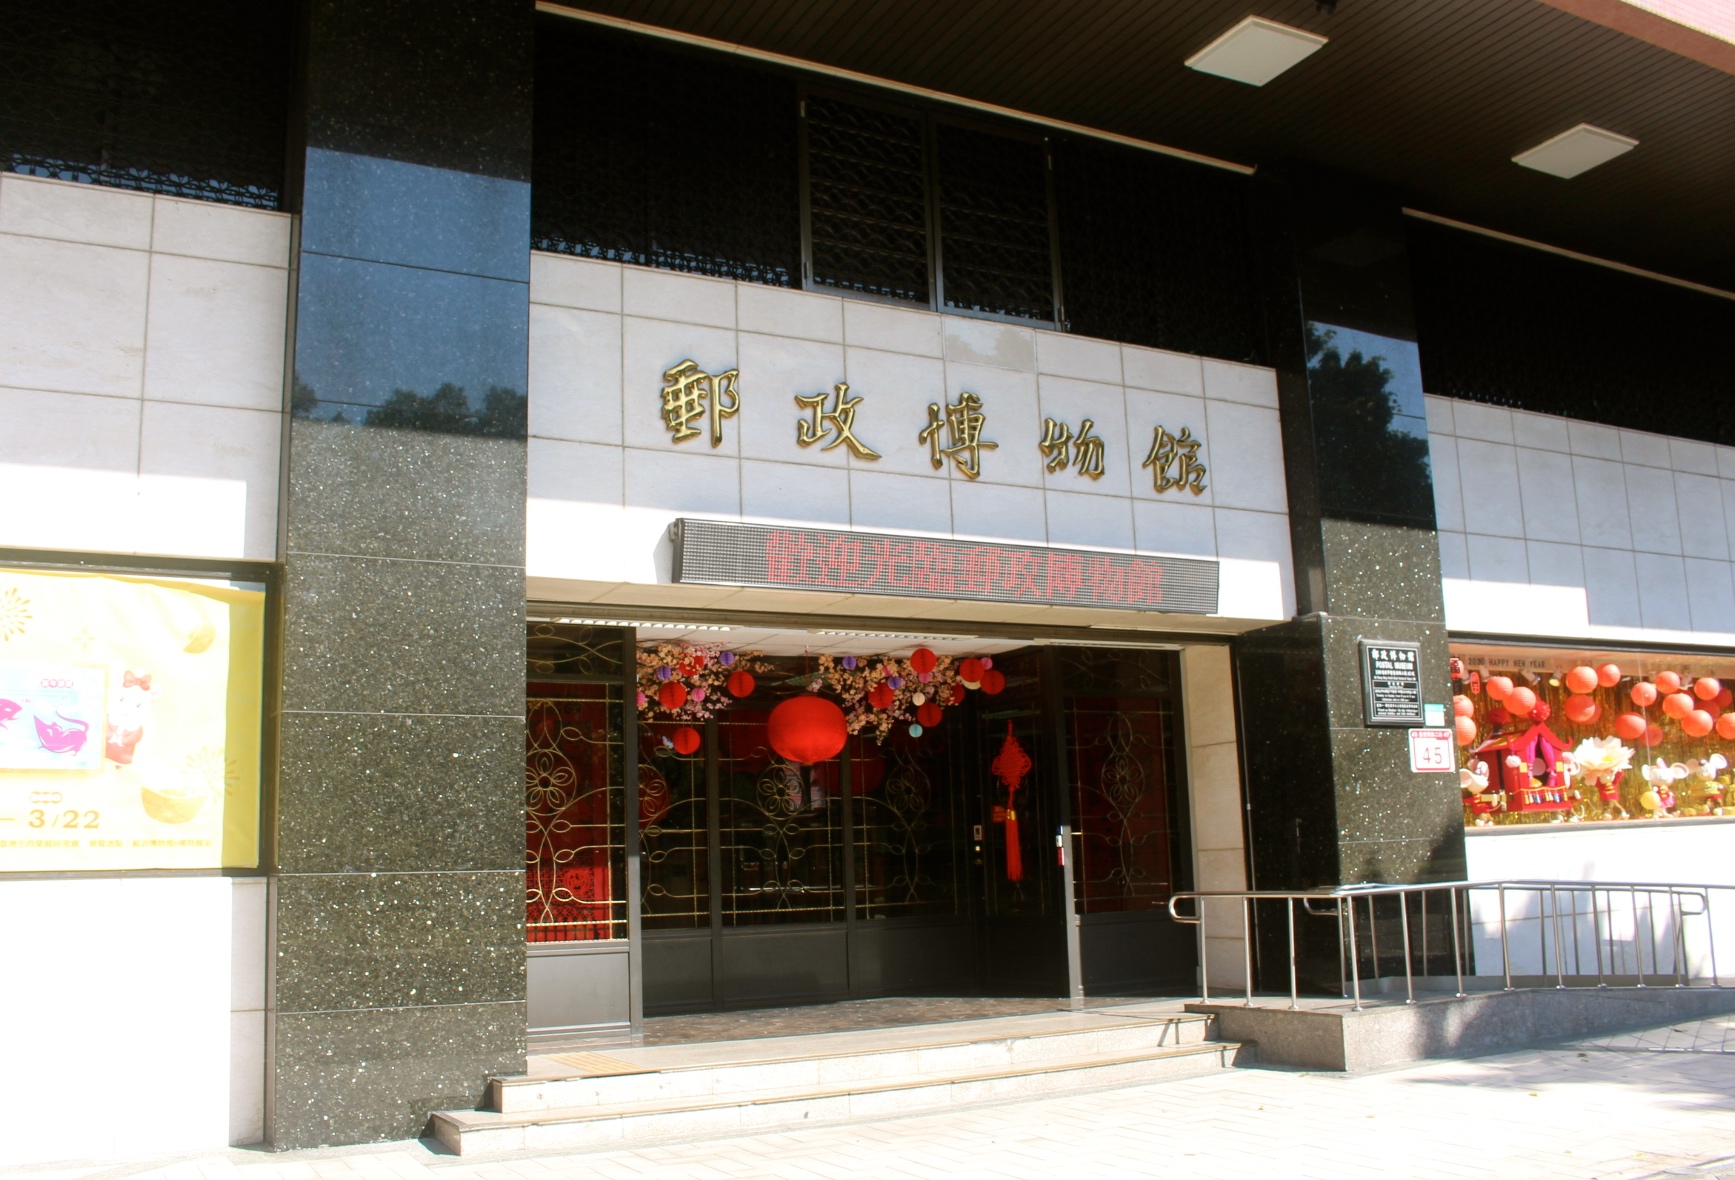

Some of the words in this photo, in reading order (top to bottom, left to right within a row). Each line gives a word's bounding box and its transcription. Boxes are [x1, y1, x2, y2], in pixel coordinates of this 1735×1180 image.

[660, 359, 1209, 496] 郵政博物館
[764, 530, 1165, 605] 歡迎光臨郵政博物館
[1489, 658, 1509, 667] HAPPY
[1513, 659, 1526, 668] NEW
[1529, 660, 1546, 669] YEAR
[1422, 746, 1443, 765] 45
